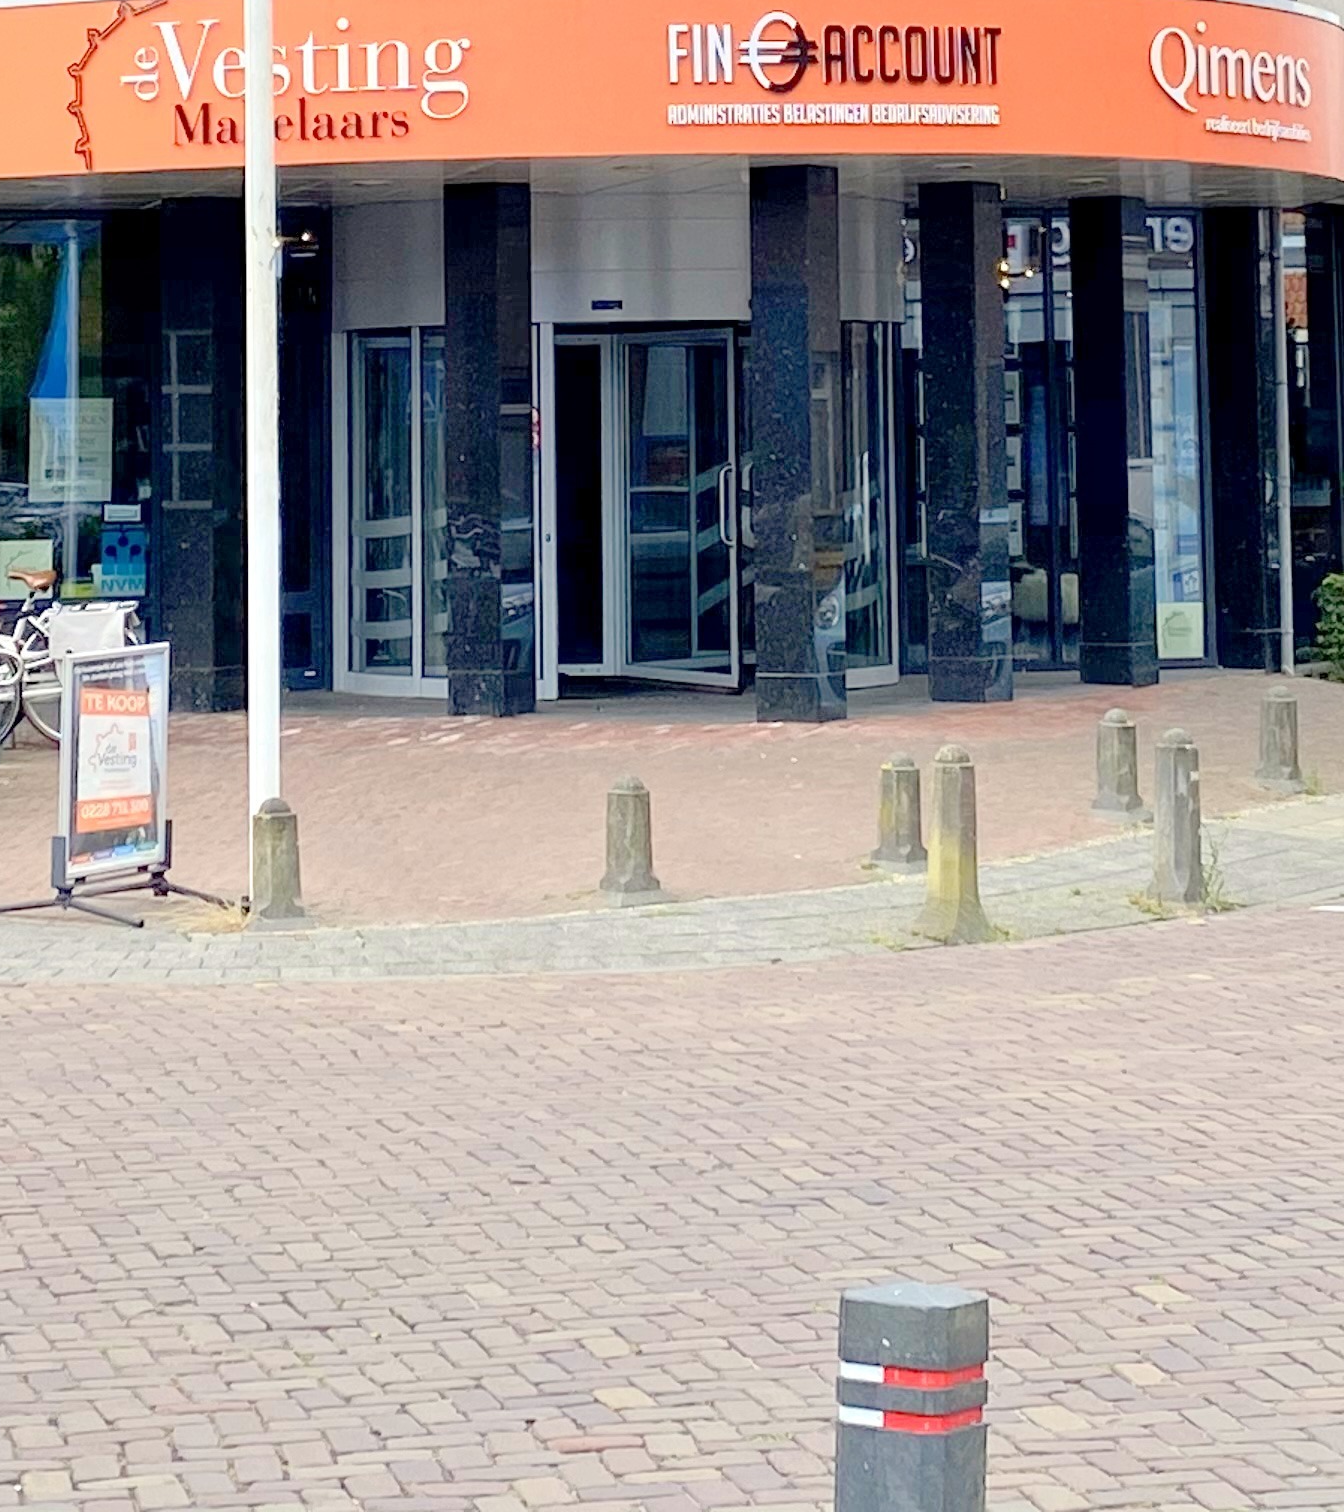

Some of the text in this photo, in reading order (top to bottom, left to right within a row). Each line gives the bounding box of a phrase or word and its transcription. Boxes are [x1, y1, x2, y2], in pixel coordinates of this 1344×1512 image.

[120, 44, 160, 102] de
[667, 23, 733, 85] FIN
[822, 24, 1002, 86] ACCOUNT
[1149, 19, 1313, 113] Qimens
[173, 96, 411, 148] Maelaars
[667, 103, 781, 126] ADMINISTRATIES
[783, 103, 871, 126] BELASTINGEN
[84, 693, 146, 713] TE KOOP
